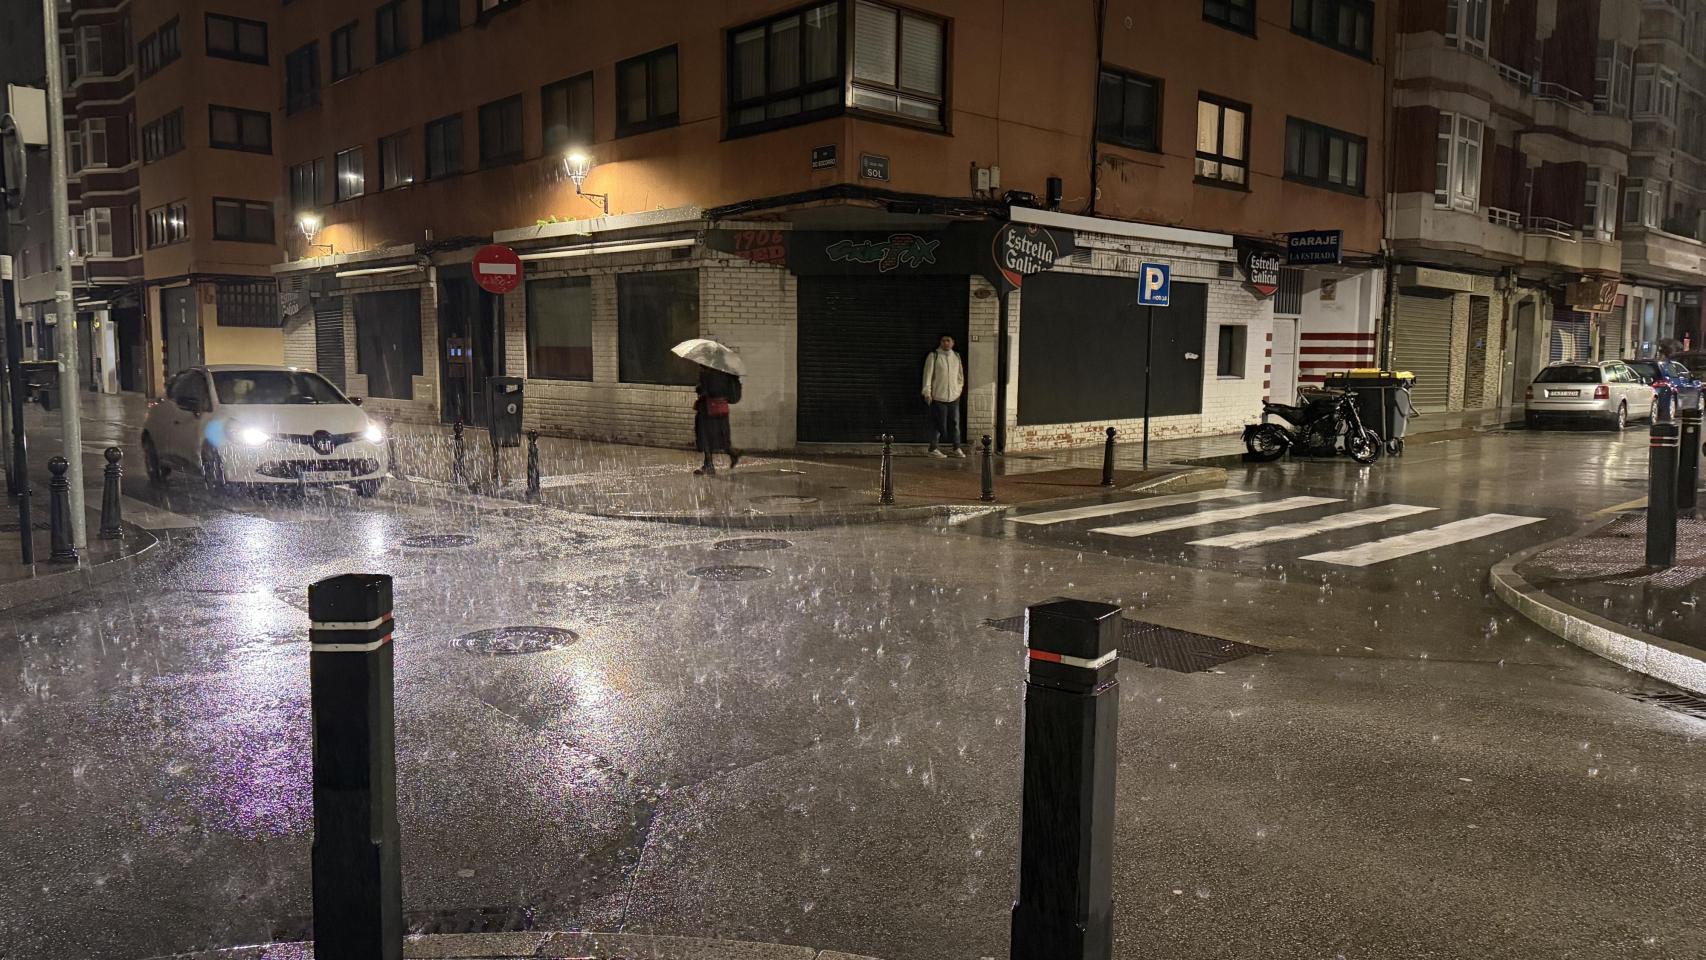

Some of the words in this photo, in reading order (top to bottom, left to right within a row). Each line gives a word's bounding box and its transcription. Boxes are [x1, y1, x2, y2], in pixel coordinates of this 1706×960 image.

[867, 168, 883, 178] SOL
[735, 230, 784, 250] 1906
[1006, 229, 1053, 263] Estrella
[1290, 235, 1337, 247] GARAJE
[1006, 249, 1046, 274] Galici
[1250, 255, 1279, 271] Estrella
[1290, 251, 1300, 261] LA
[1301, 249, 1335, 260] ESTRADA
[1144, 267, 1165, 300] P
[1251, 269, 1277, 285] Galicia
